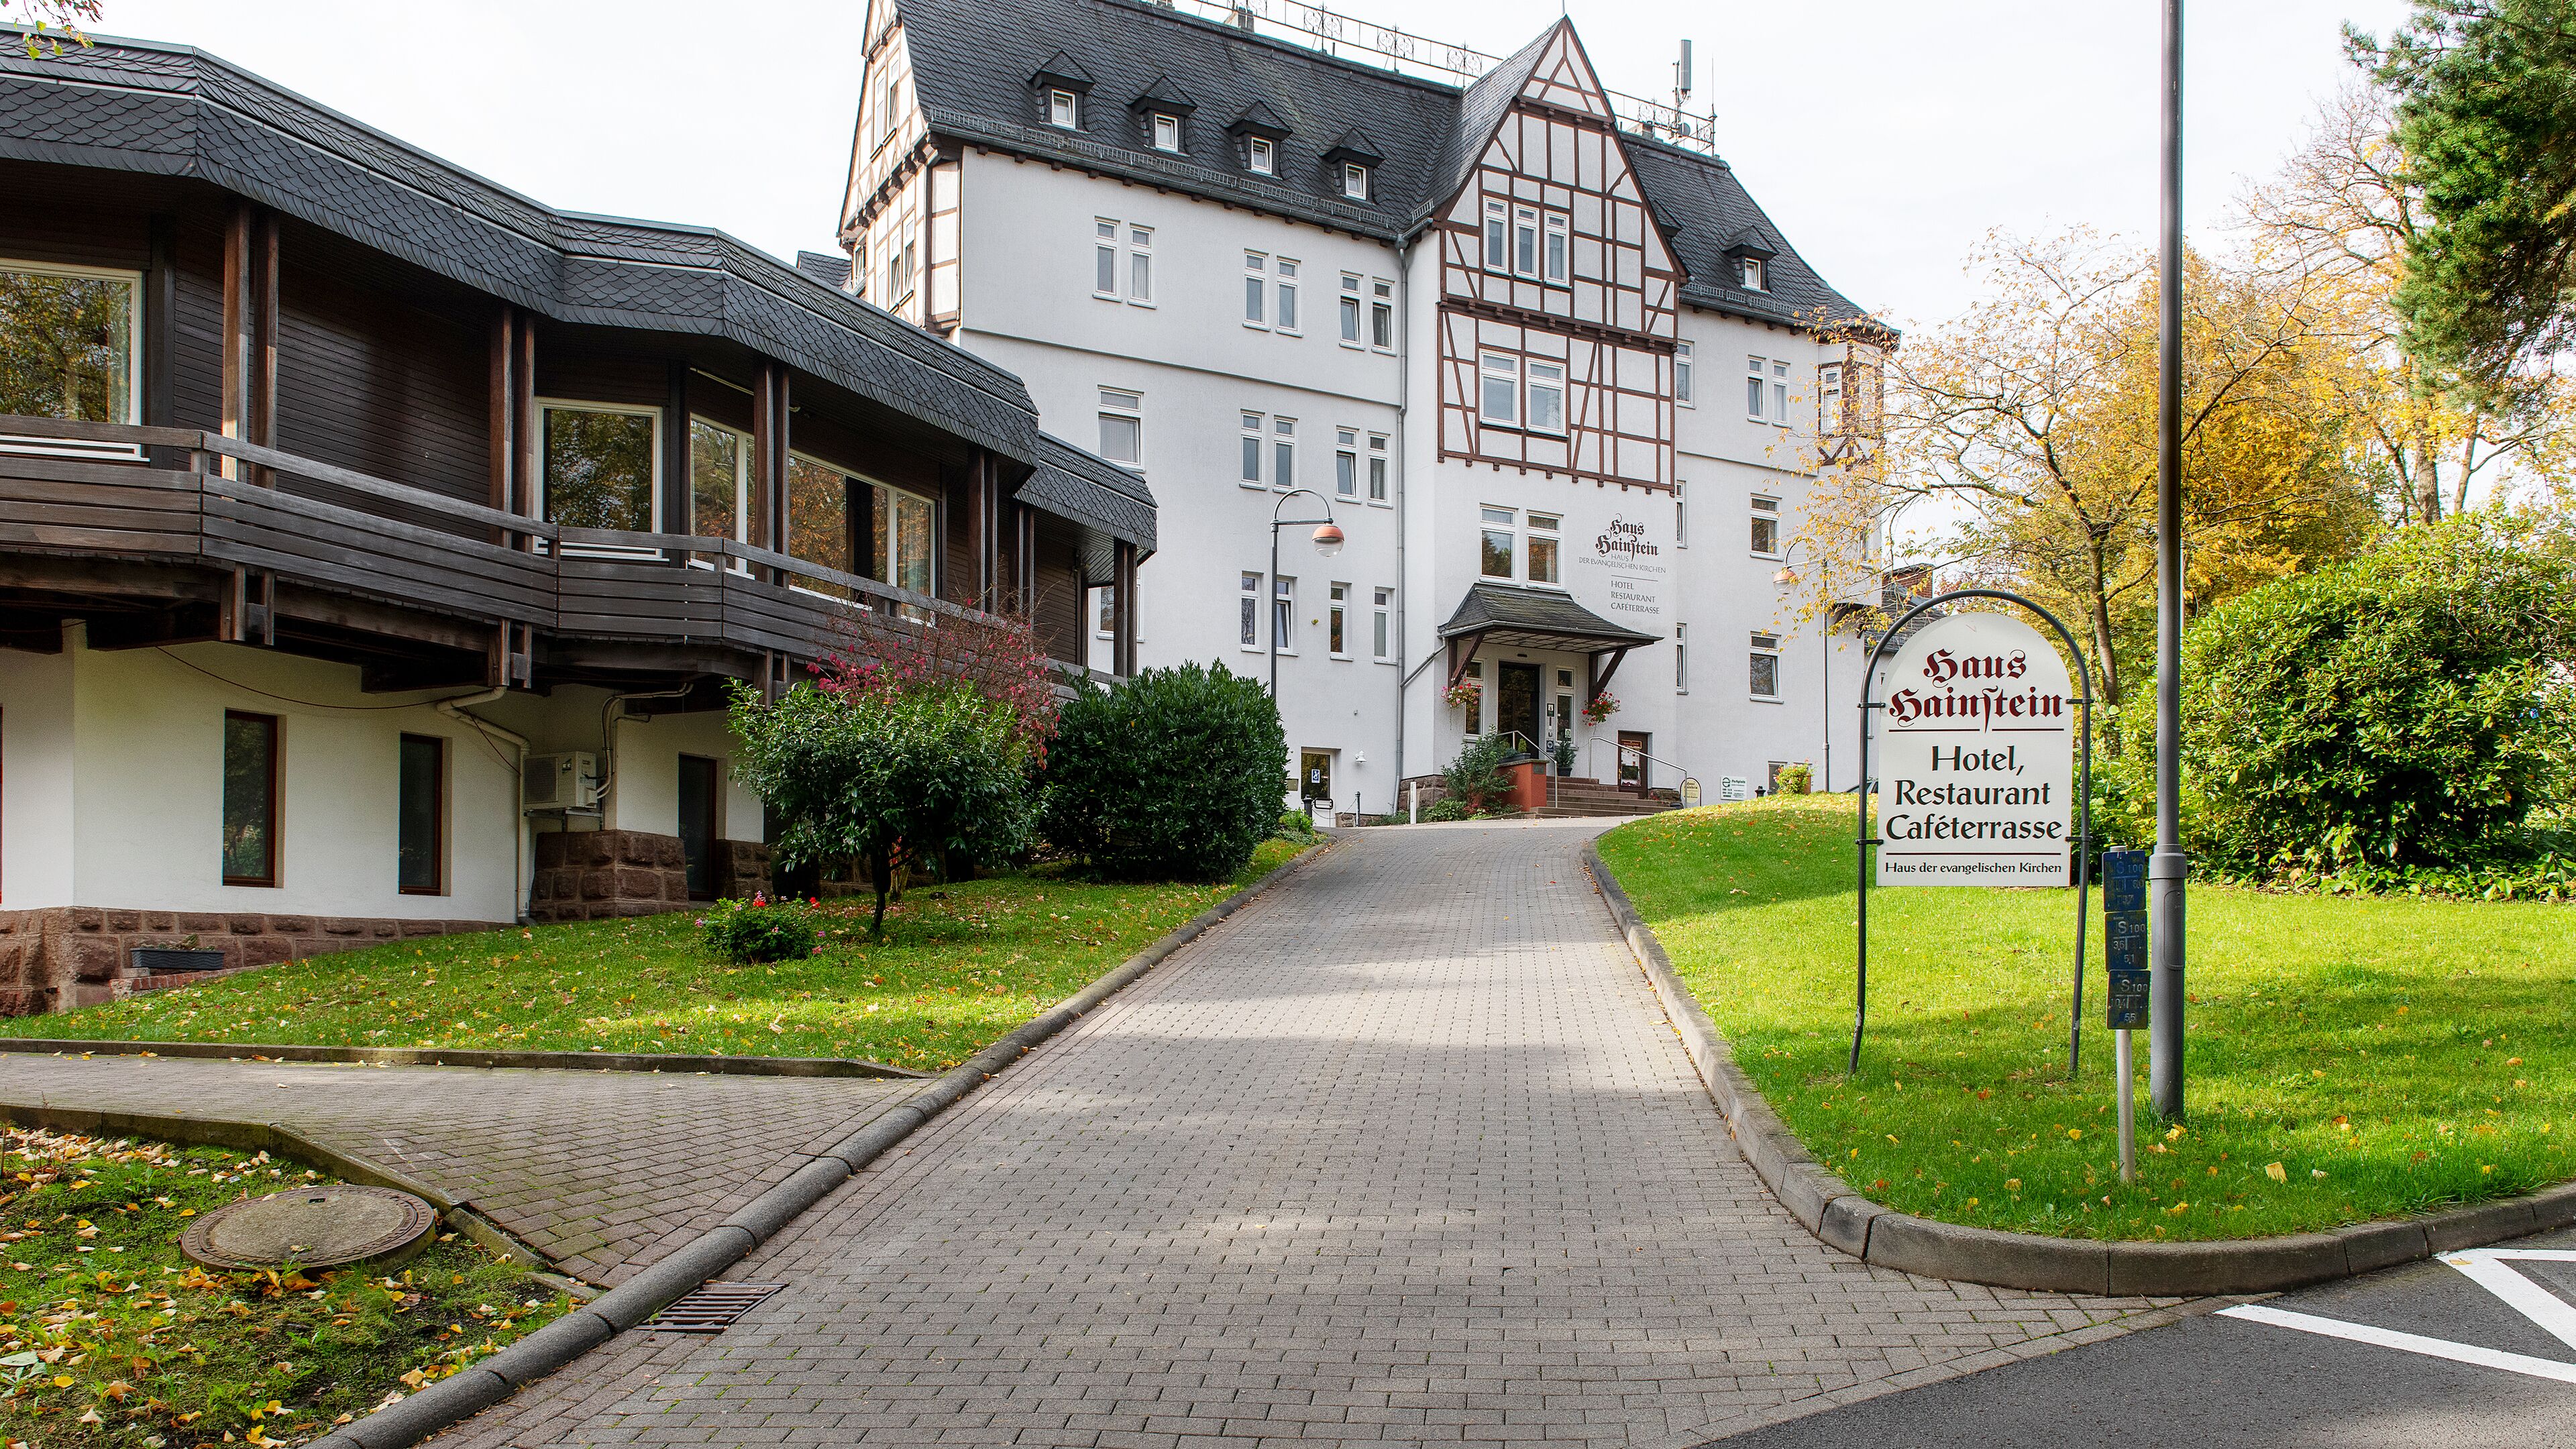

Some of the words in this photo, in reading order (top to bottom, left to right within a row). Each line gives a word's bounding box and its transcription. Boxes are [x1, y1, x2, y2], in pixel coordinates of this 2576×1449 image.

[1610, 513, 1644, 537] Haus
[1611, 553, 1629, 561] HAUS
[1591, 559, 1638, 570] EVANGELISCHEN
[1639, 564, 1666, 574] KIRCHEN
[1611, 580, 1634, 590] HOTEL
[1611, 591, 1656, 603] RESTAURANT
[1611, 602, 1660, 614] CAFÉTERRASSE
[1923, 648, 2027, 688] Haus
[1931, 745, 2025, 776] Hotel,
[1894, 780, 2051, 806] Restaurant
[1886, 813, 2062, 840] Caféterrasse
[1885, 862, 1917, 873] Haus
[1919, 862, 1937, 873] der
[1939, 862, 2016, 875] evangelischen
[2019, 862, 2061, 873] Kirchen
[2127, 863, 2144, 873] 100
[2118, 920, 2127, 934] S
[2129, 923, 2146, 933] 100
[2121, 979, 2131, 992] S
[2131, 983, 2148, 992] 100
